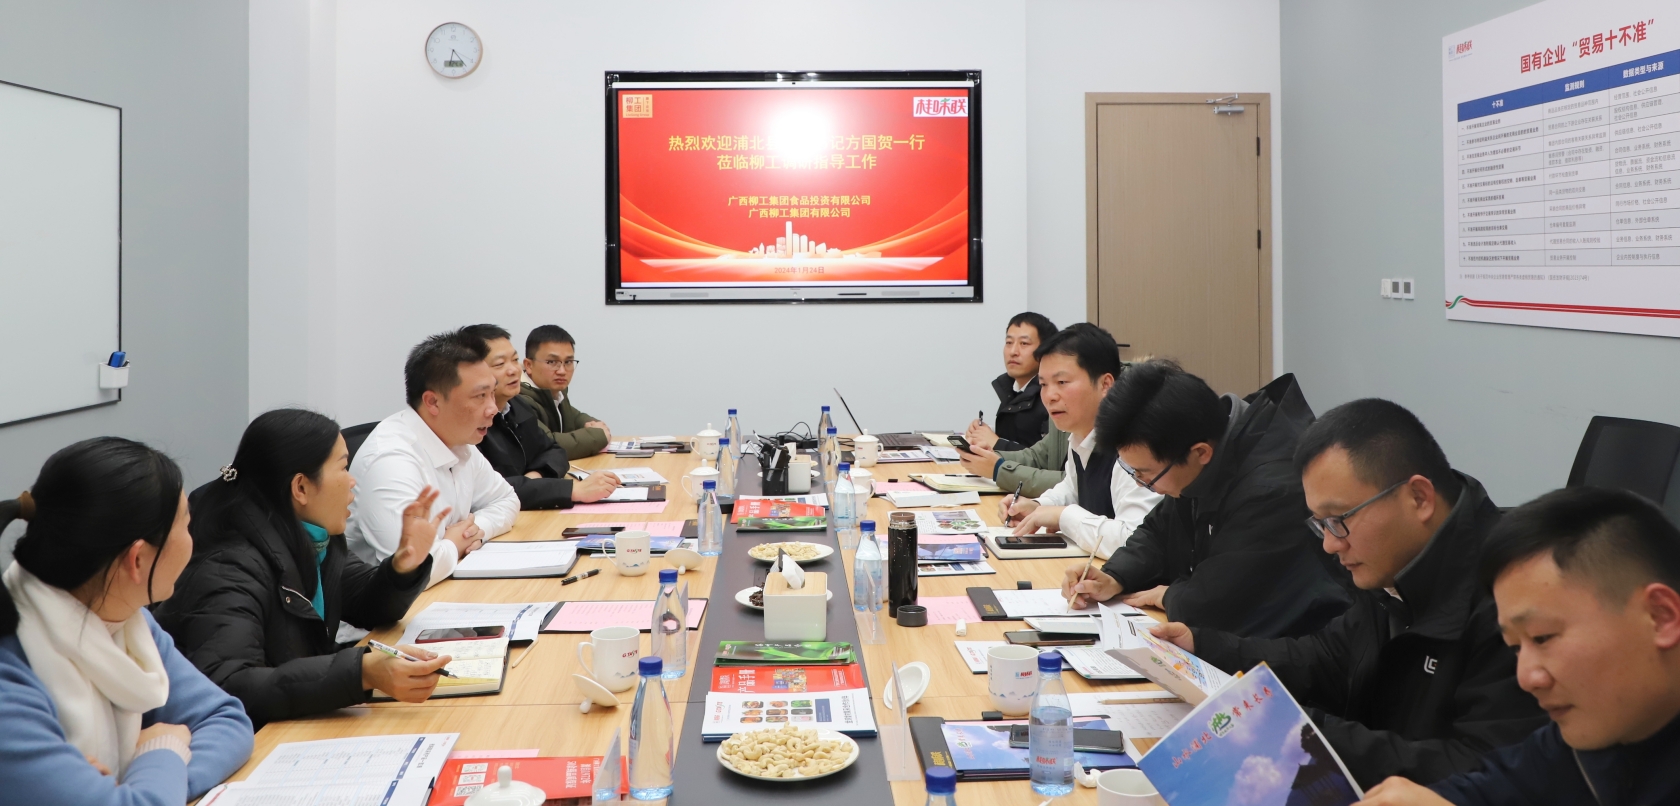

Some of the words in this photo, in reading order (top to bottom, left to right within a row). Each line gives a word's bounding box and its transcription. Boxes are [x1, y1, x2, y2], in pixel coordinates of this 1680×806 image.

[1622, 60, 1665, 79] 数据类型与来源
[915, 98, 968, 115] 桂味联
[668, 134, 926, 151] 热烈欢迎浦北县记方国贺一行
[728, 195, 871, 207] 广西柳工集团食品投资有限公司
[748, 207, 851, 218] 广西柳工集团有限公司
[774, 266, 825, 275] 2024年1月24日
